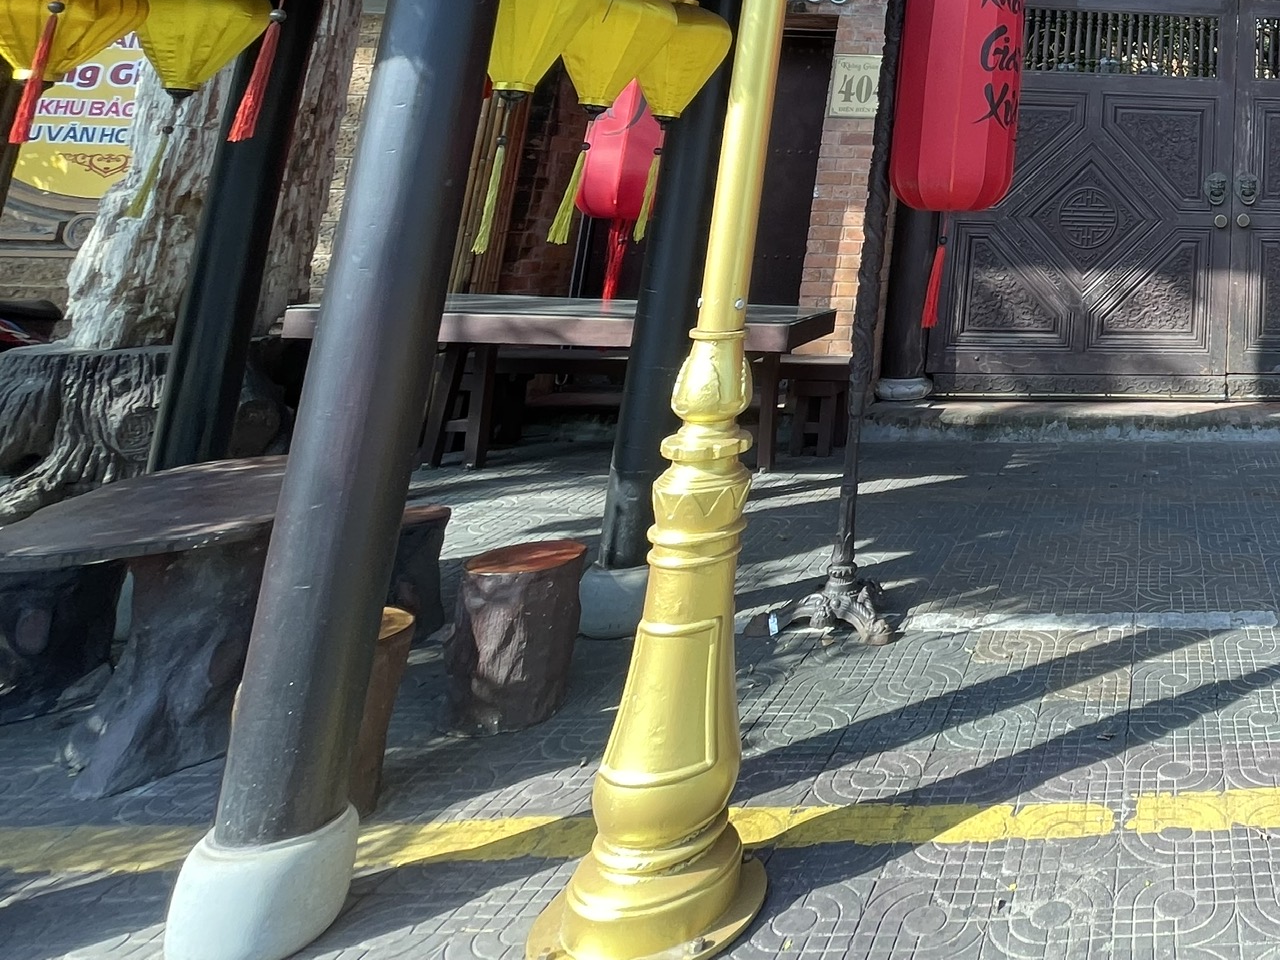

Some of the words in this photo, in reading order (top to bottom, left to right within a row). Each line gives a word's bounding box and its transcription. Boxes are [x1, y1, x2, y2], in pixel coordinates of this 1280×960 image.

[838, 74, 878, 103] 40
[39, 100, 85, 116] KHU
[48, 123, 97, 144] VĂN
